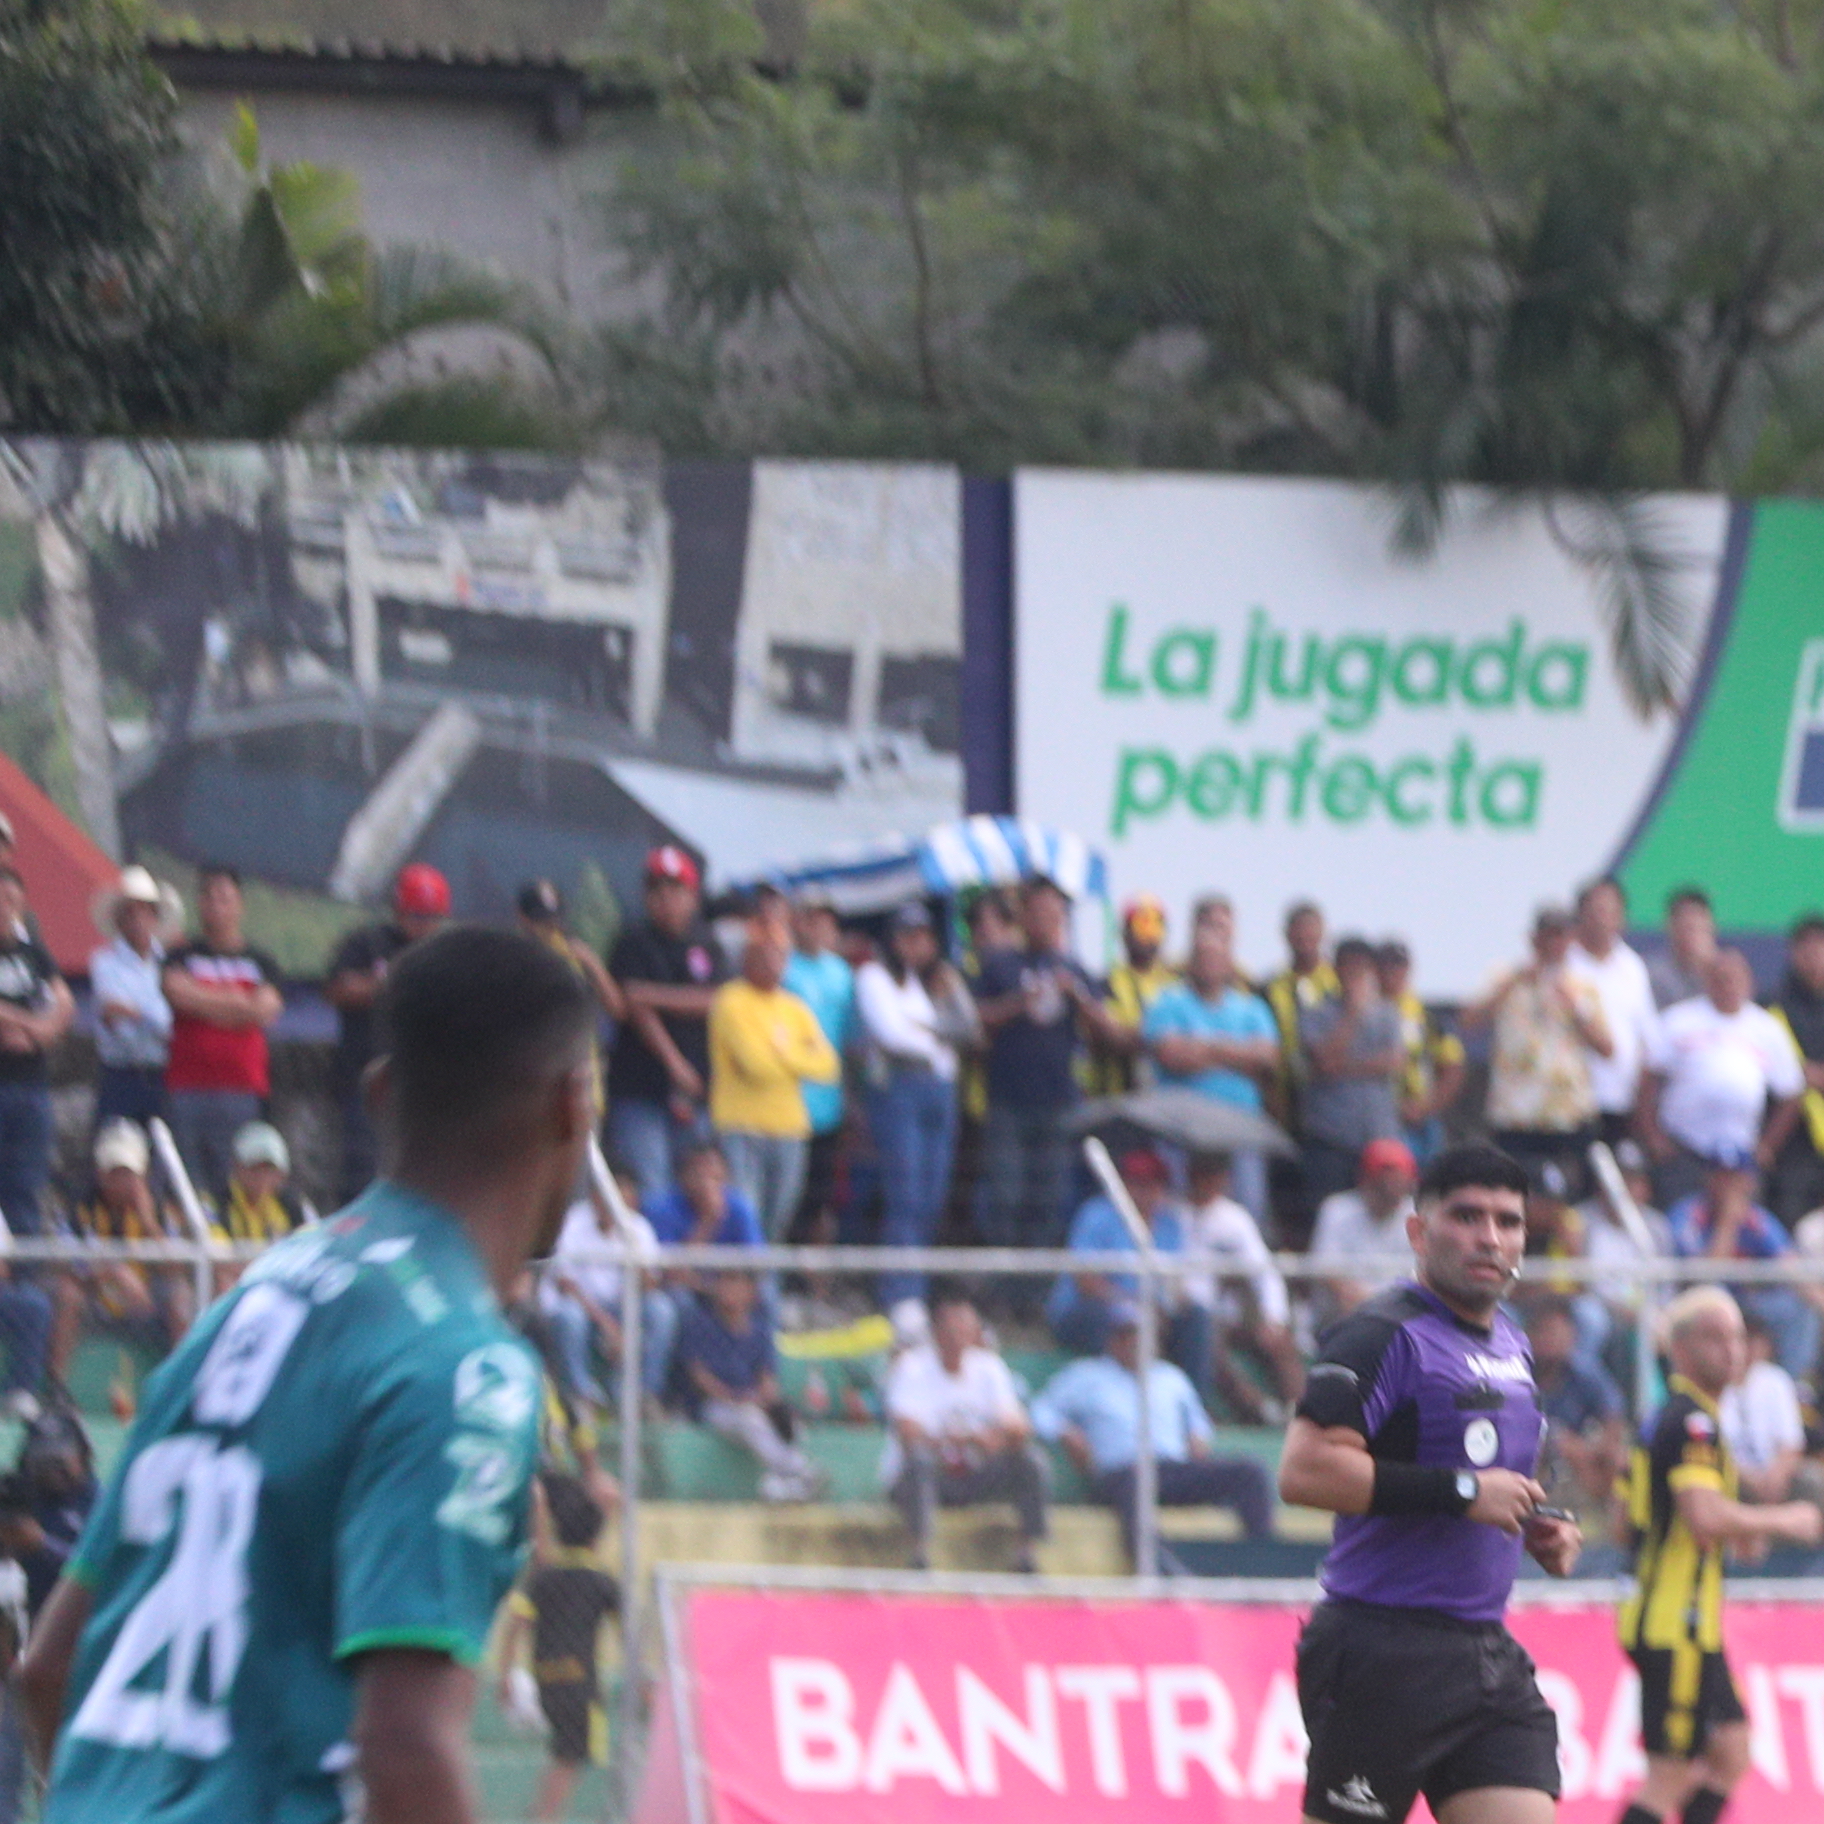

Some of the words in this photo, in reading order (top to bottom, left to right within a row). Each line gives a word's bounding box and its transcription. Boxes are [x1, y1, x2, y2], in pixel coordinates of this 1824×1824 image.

[1099, 602, 1217, 700] La
[1228, 606, 1594, 731] jugada
[1107, 733, 1545, 840] perfecta
[769, 1655, 1309, 1797] BANTRA
